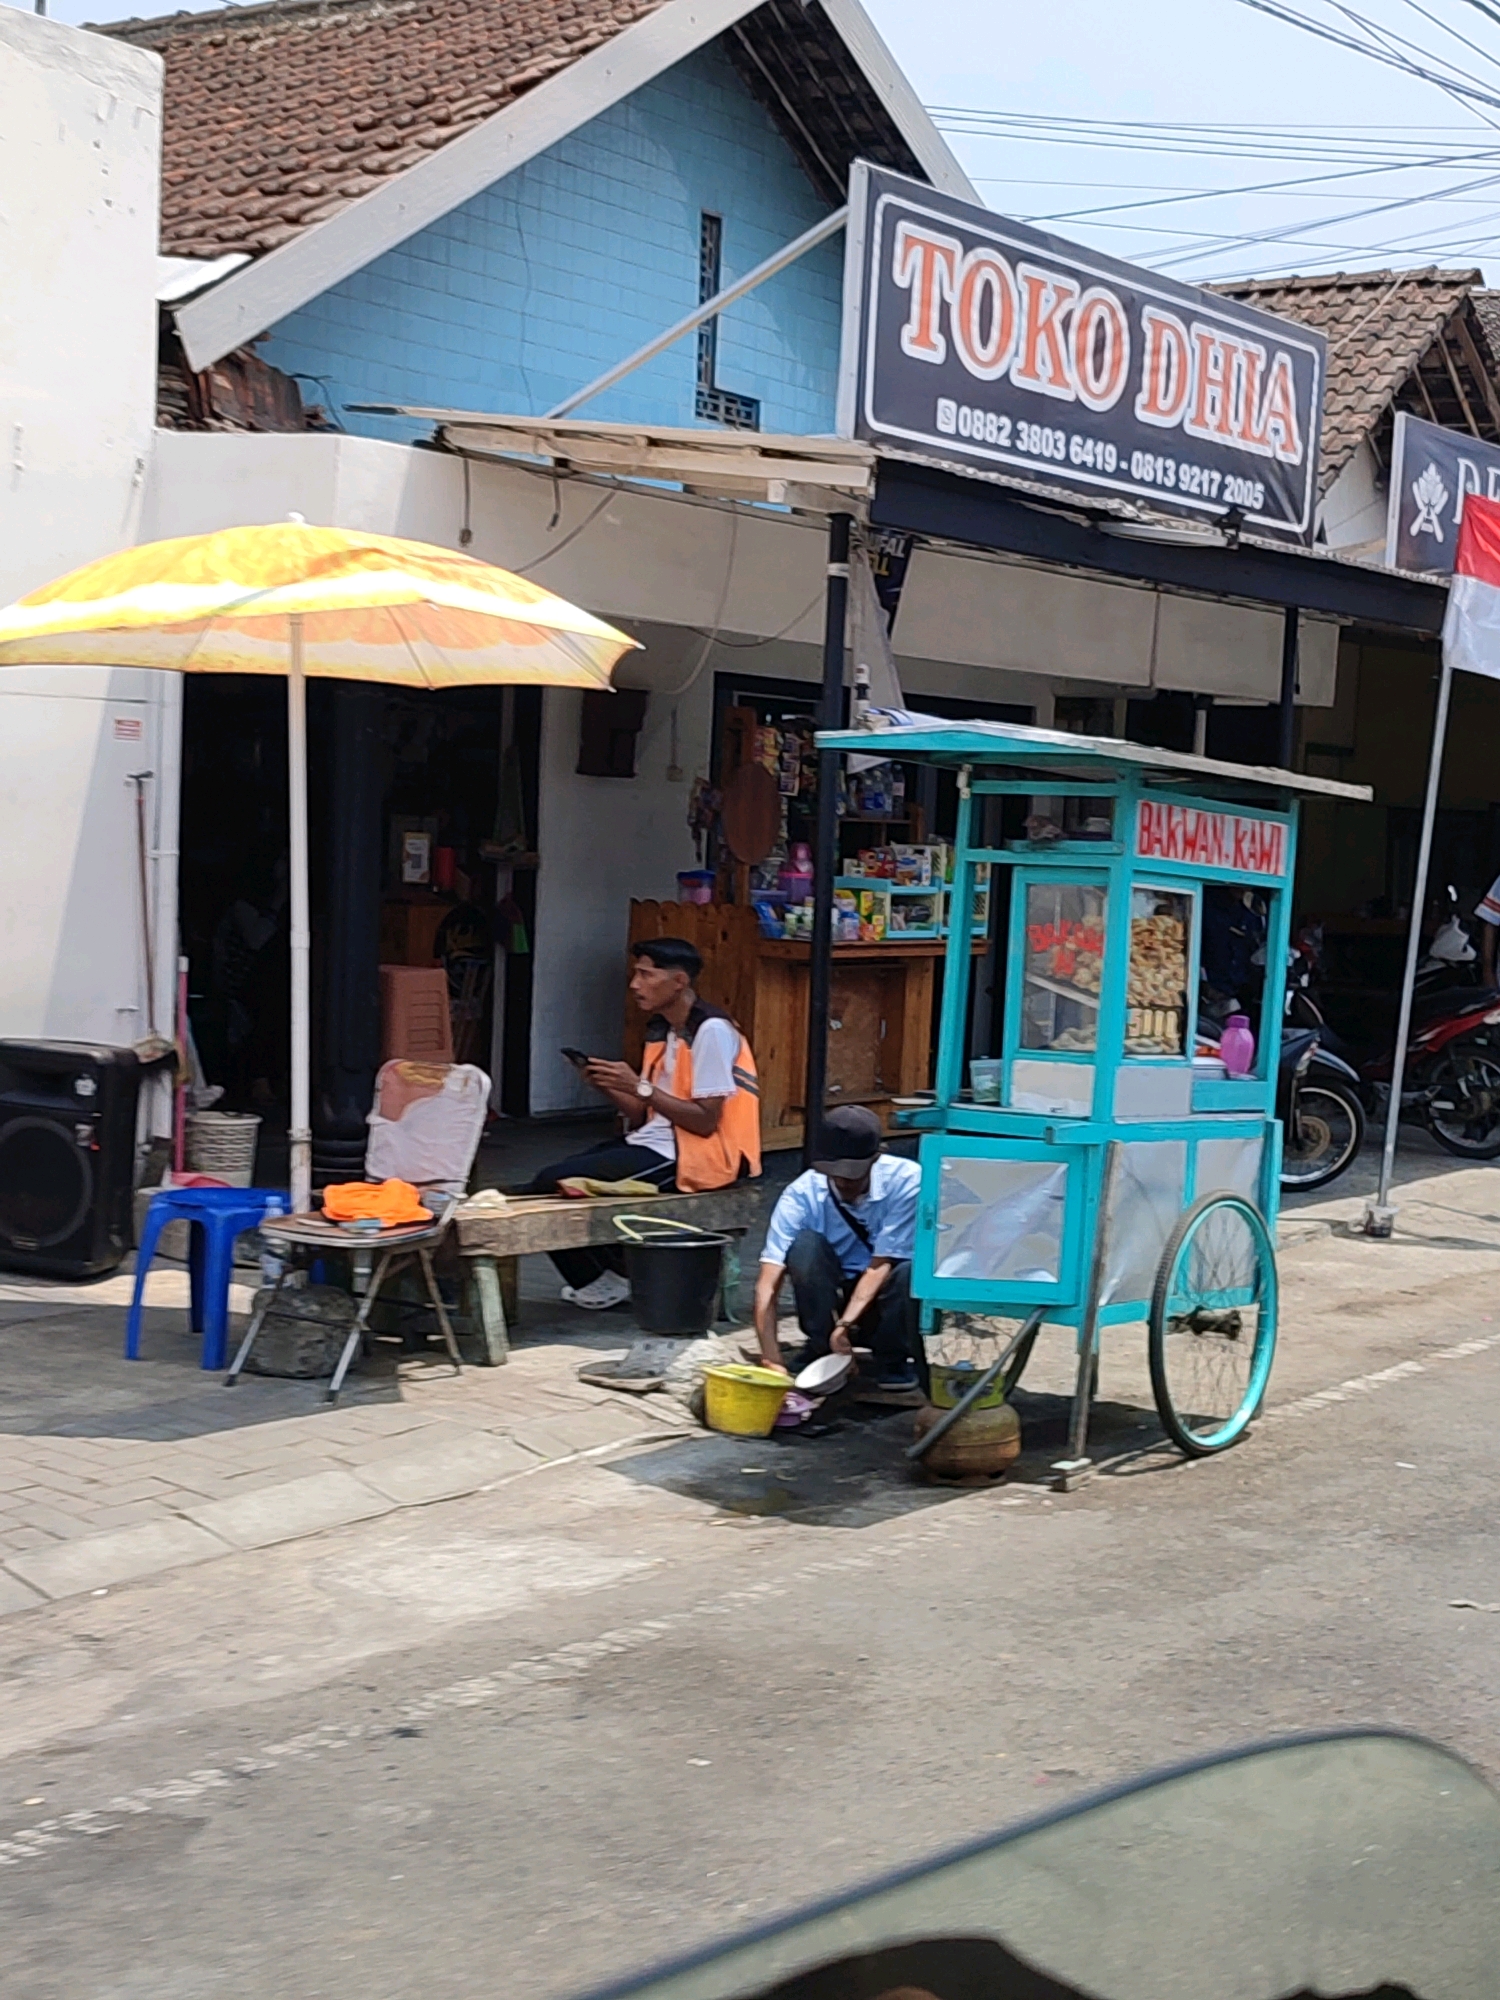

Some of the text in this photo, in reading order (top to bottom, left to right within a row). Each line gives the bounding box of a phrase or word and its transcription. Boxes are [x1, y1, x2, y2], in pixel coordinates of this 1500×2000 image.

[893, 220, 1303, 464] TOKO DHIA
[958, 405, 1012, 447] 0882
[1015, 420, 1066, 461] 3803
[1069, 434, 1117, 473] 6419
[1130, 450, 1176, 488] 0813
[1178, 463, 1222, 499] 9217
[1223, 474, 1265, 510] 2005
